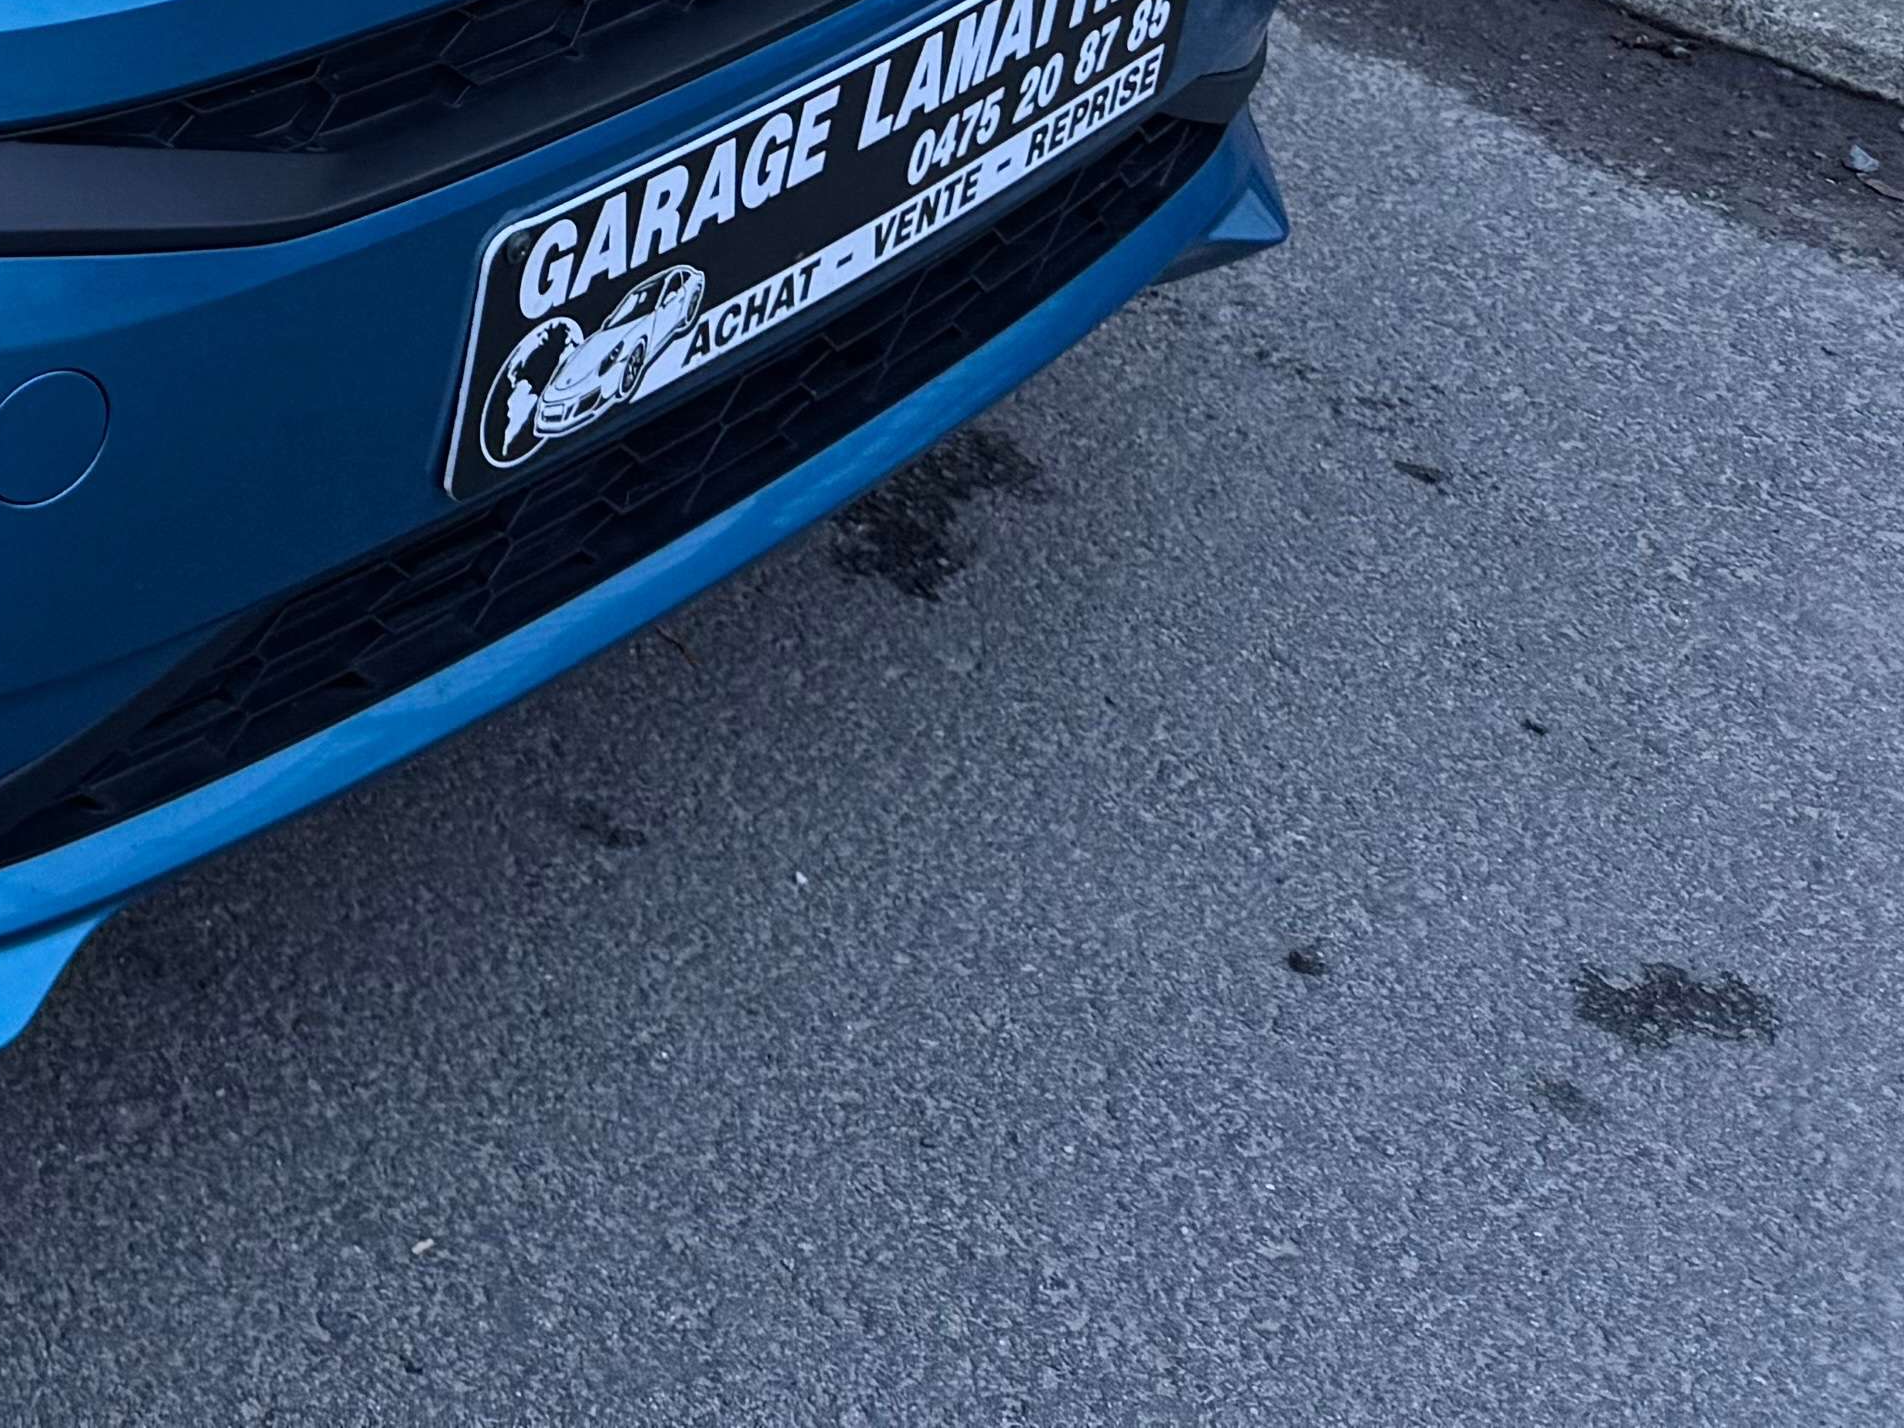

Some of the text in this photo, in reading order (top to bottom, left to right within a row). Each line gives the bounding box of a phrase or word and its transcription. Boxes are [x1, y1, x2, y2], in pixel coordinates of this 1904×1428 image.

[520, 97, 833, 321] GARAGE
[682, 261, 820, 368] ACHAT
[873, 171, 980, 258] VENTE
[1028, 52, 1163, 166] REPRISE
[906, 85, 1003, 187] 0475
[1015, 54, 1058, 123] 20
[1075, 28, 1116, 86] 87
